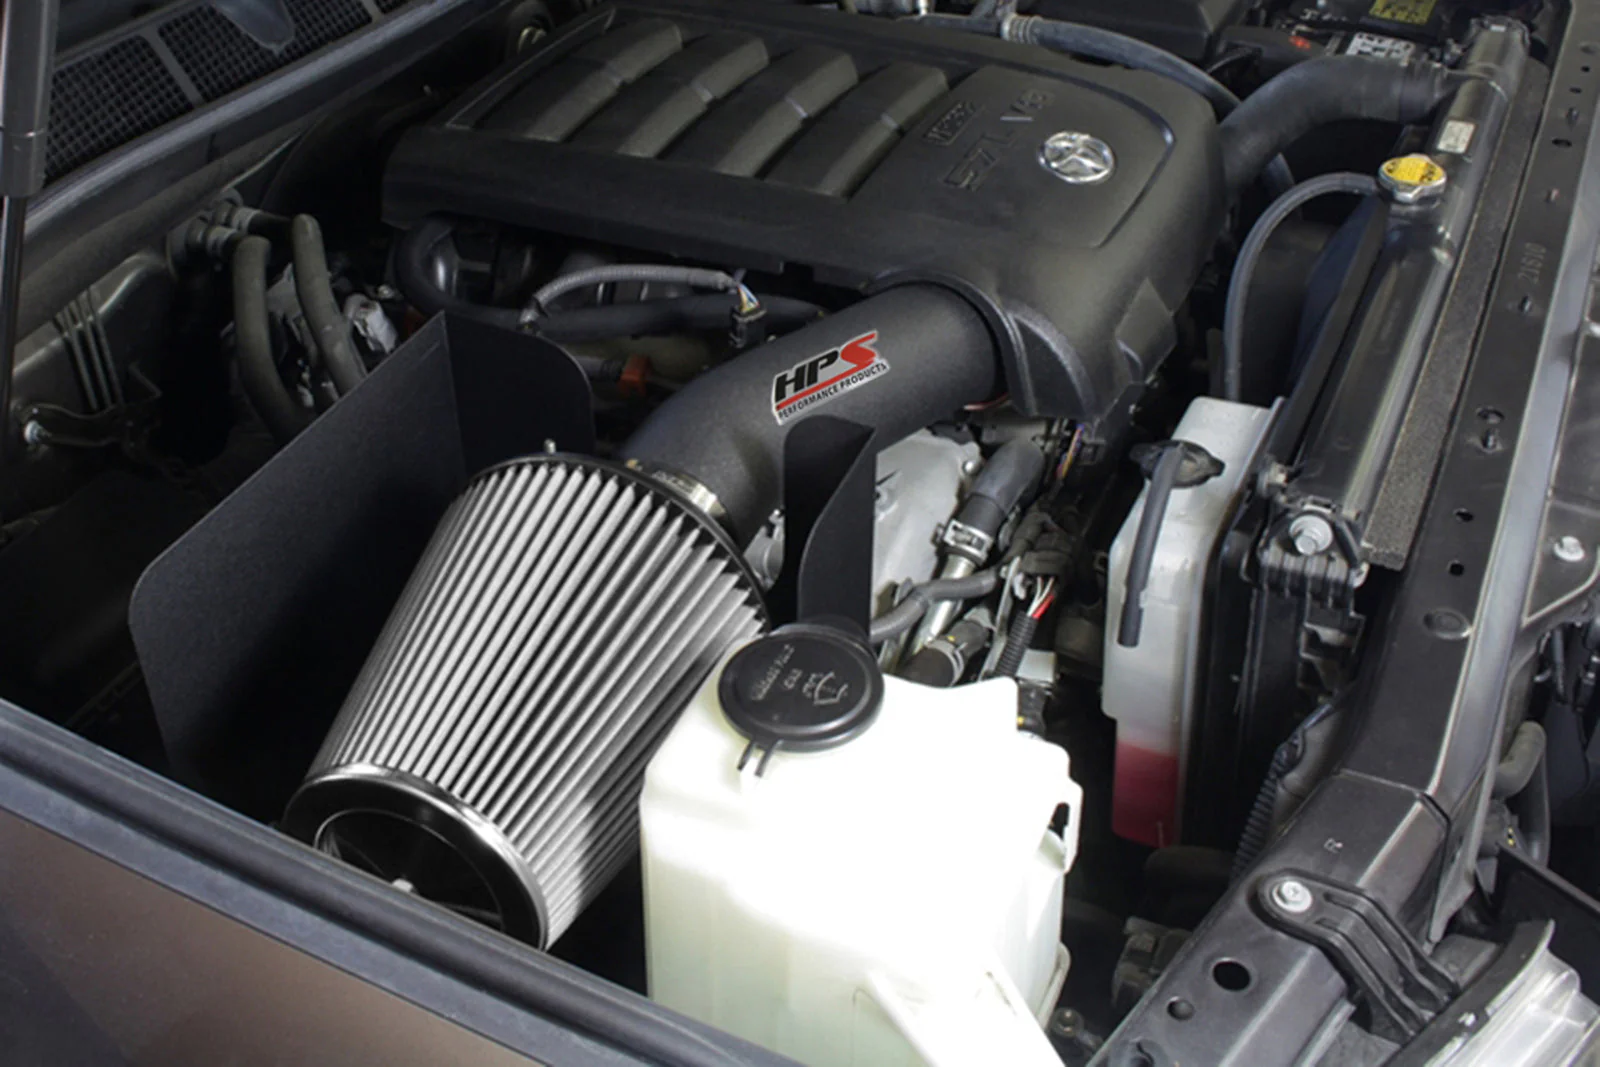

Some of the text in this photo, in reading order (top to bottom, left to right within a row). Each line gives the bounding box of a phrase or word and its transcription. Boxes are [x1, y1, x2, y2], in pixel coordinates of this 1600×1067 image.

[775, 332, 877, 403] HPS
[778, 363, 887, 419] PERFORMANCE PRODUCTS
